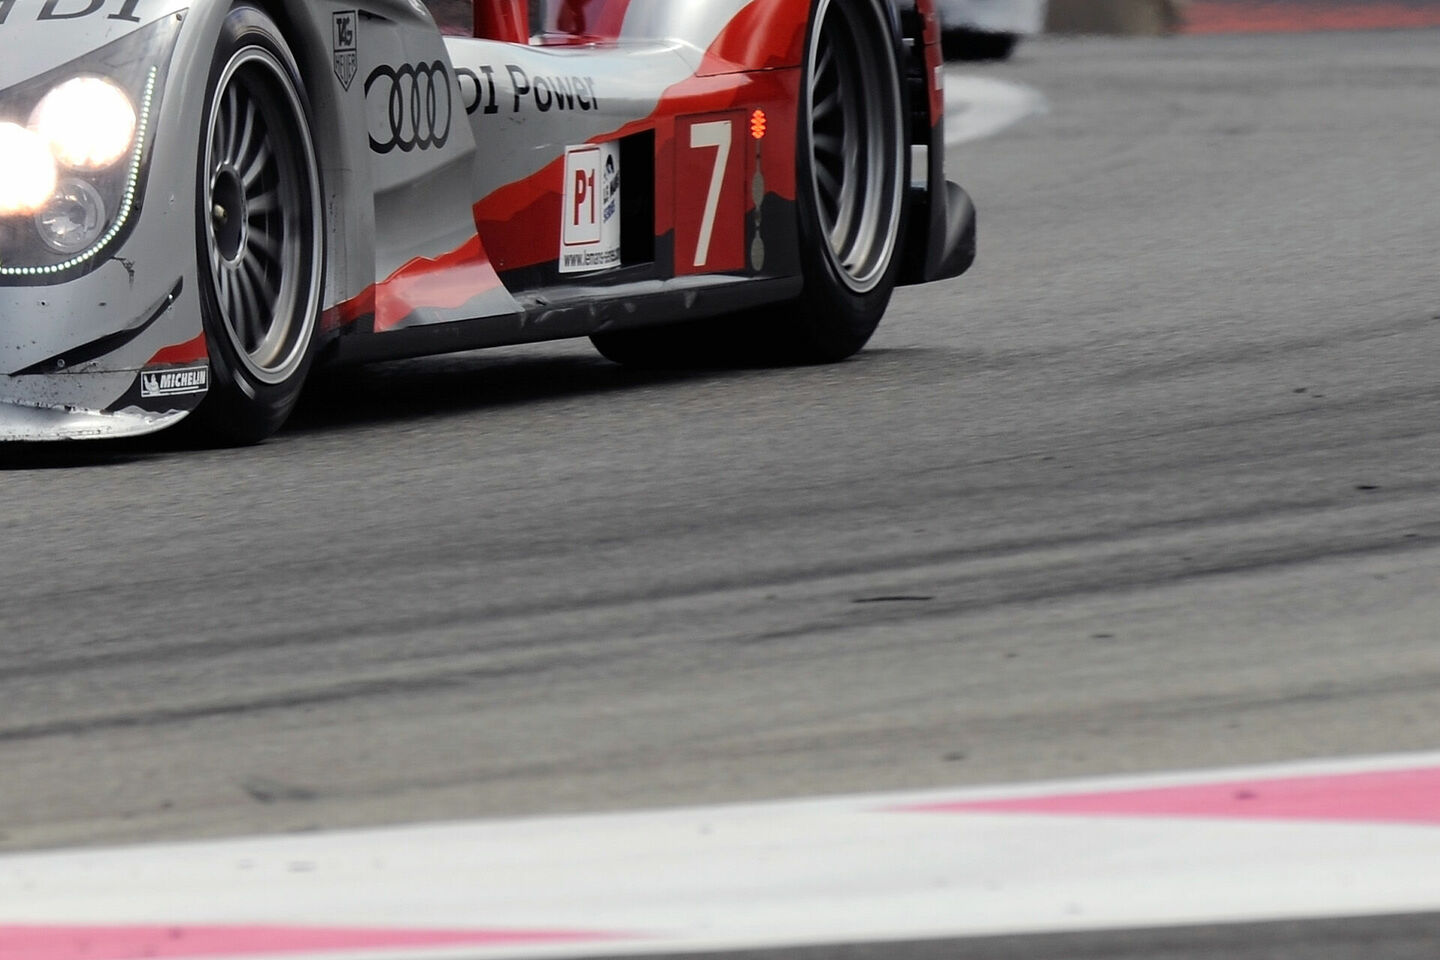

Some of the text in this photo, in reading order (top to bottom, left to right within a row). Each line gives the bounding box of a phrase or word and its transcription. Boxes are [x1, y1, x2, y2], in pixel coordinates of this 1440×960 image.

[454, 64, 599, 115] DI Power
[573, 168, 596, 226] P1
[690, 119, 733, 267] 7
[160, 369, 206, 389] MICHELIN
